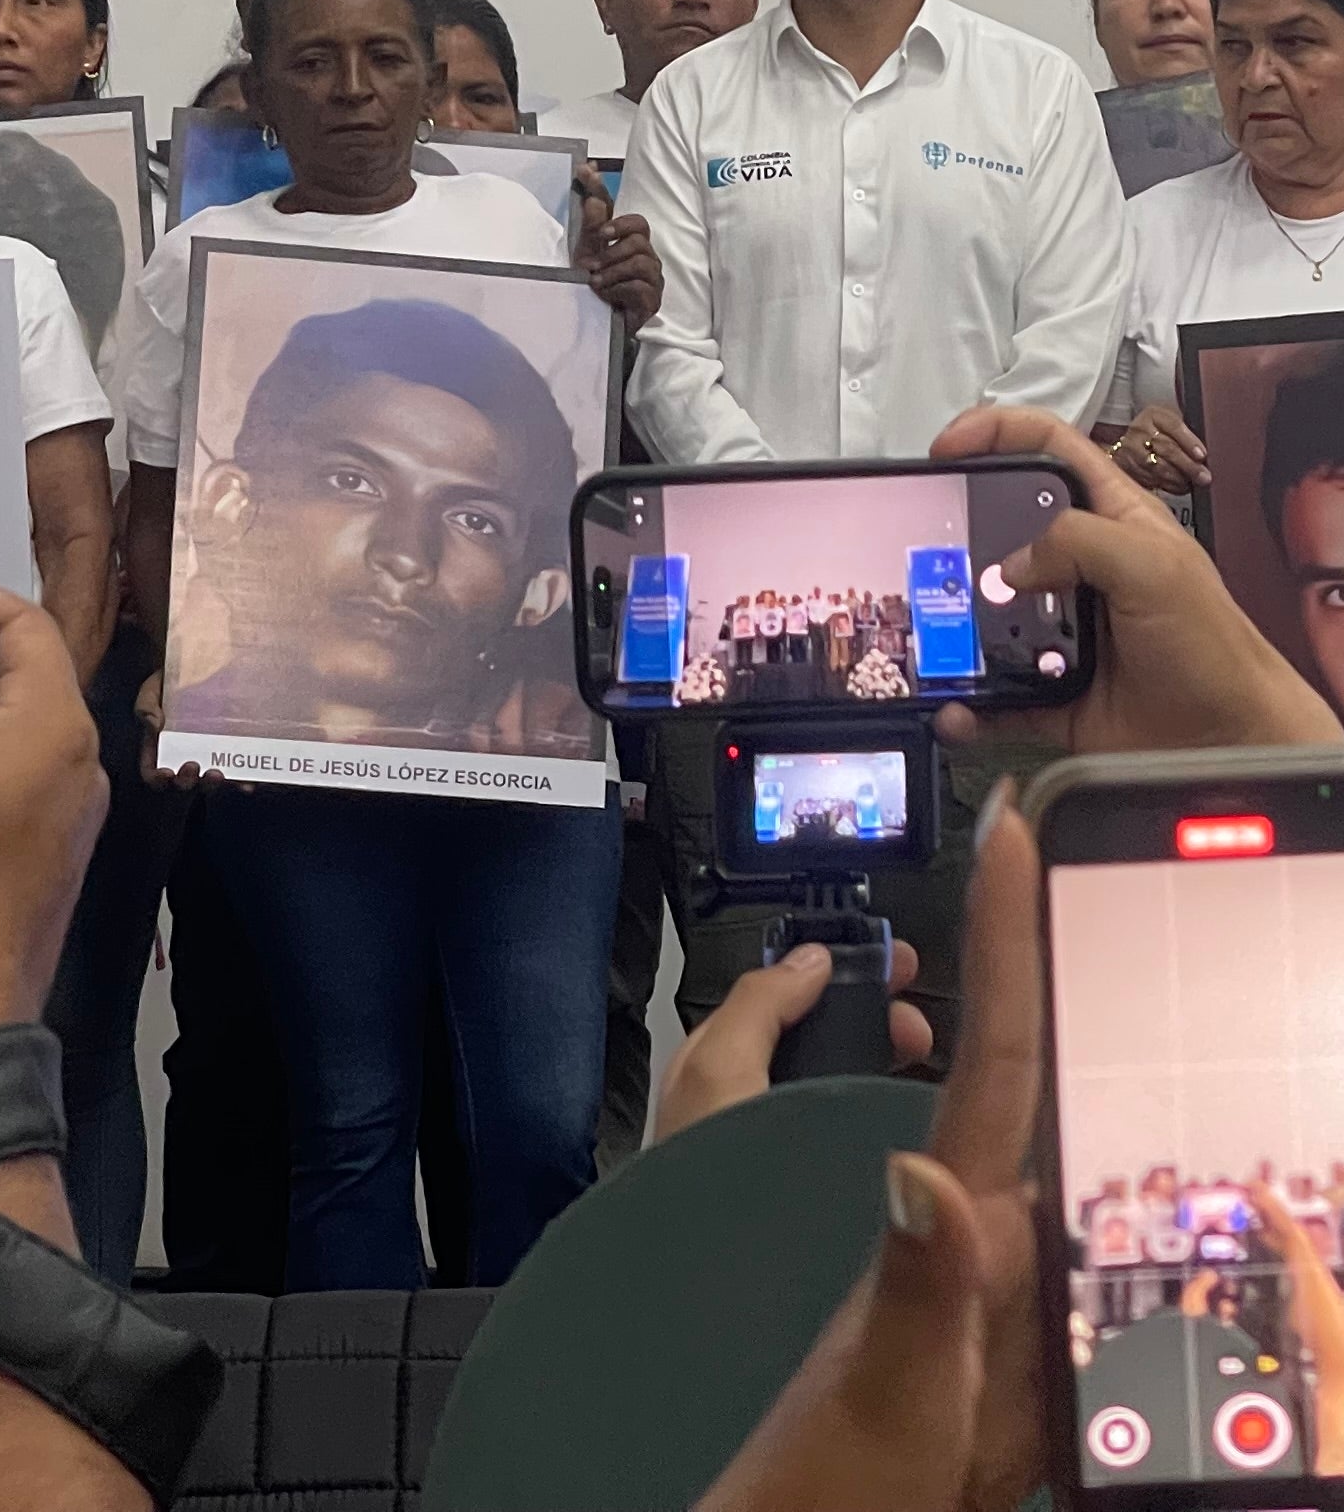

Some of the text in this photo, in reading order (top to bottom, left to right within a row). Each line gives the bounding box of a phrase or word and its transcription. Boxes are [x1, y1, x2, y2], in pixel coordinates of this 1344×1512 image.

[741, 165, 792, 181] VIDA
[956, 152, 1023, 175] Defensa
[211, 752, 553, 791] MIGUEL DE JESÚS LÓPEZ ESCORCIA
